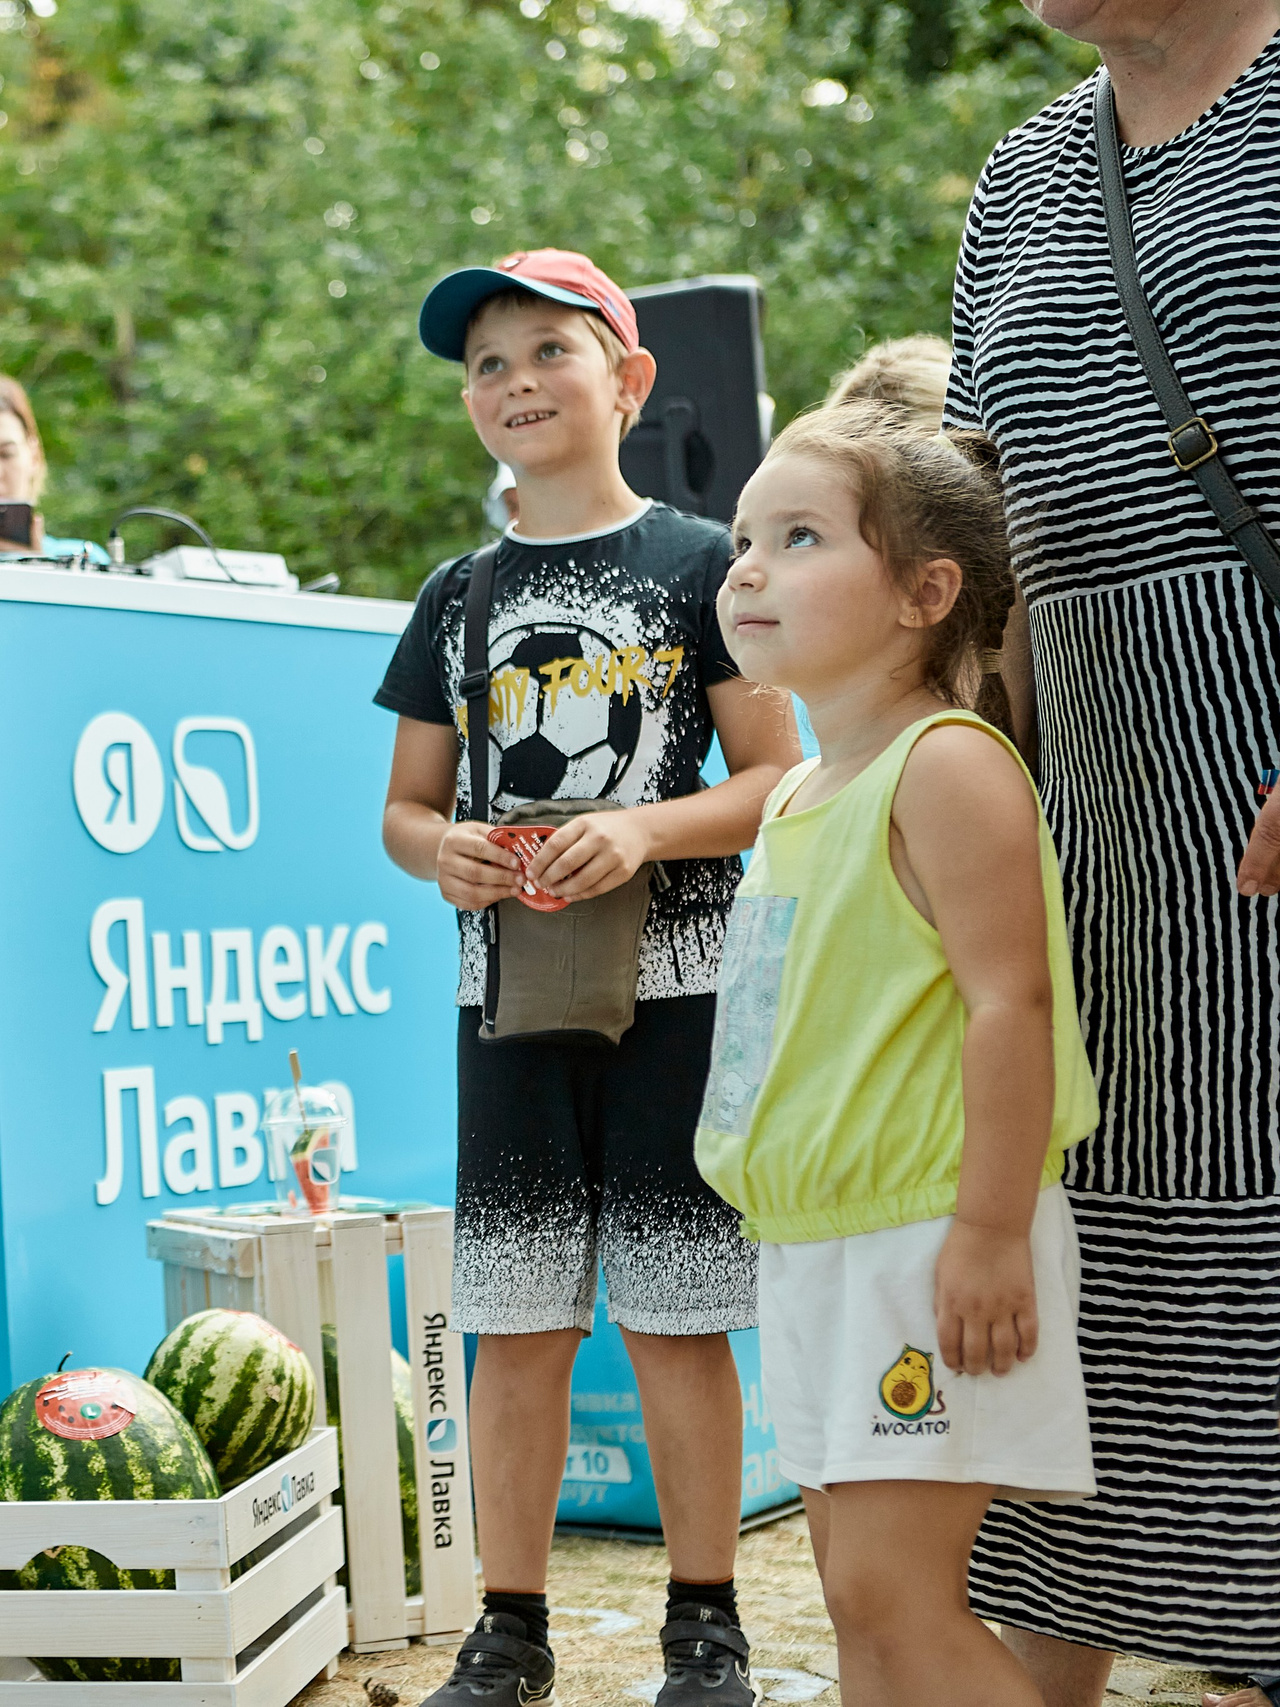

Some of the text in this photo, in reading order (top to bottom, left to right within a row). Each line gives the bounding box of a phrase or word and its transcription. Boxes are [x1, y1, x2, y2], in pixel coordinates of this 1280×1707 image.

[538, 645, 656, 718] FOUR
[653, 645, 685, 699] 7
[103, 740, 137, 826] Я
[89, 896, 392, 1045] Яндекс
[424, 1313, 448, 1414] Яндекс
[581, 1451, 609, 1475] 10
[872, 1420, 951, 1436] AVOCATO!
[252, 1471, 315, 1529] Яндекс Лавка
[429, 1460, 455, 1549] Лавка
